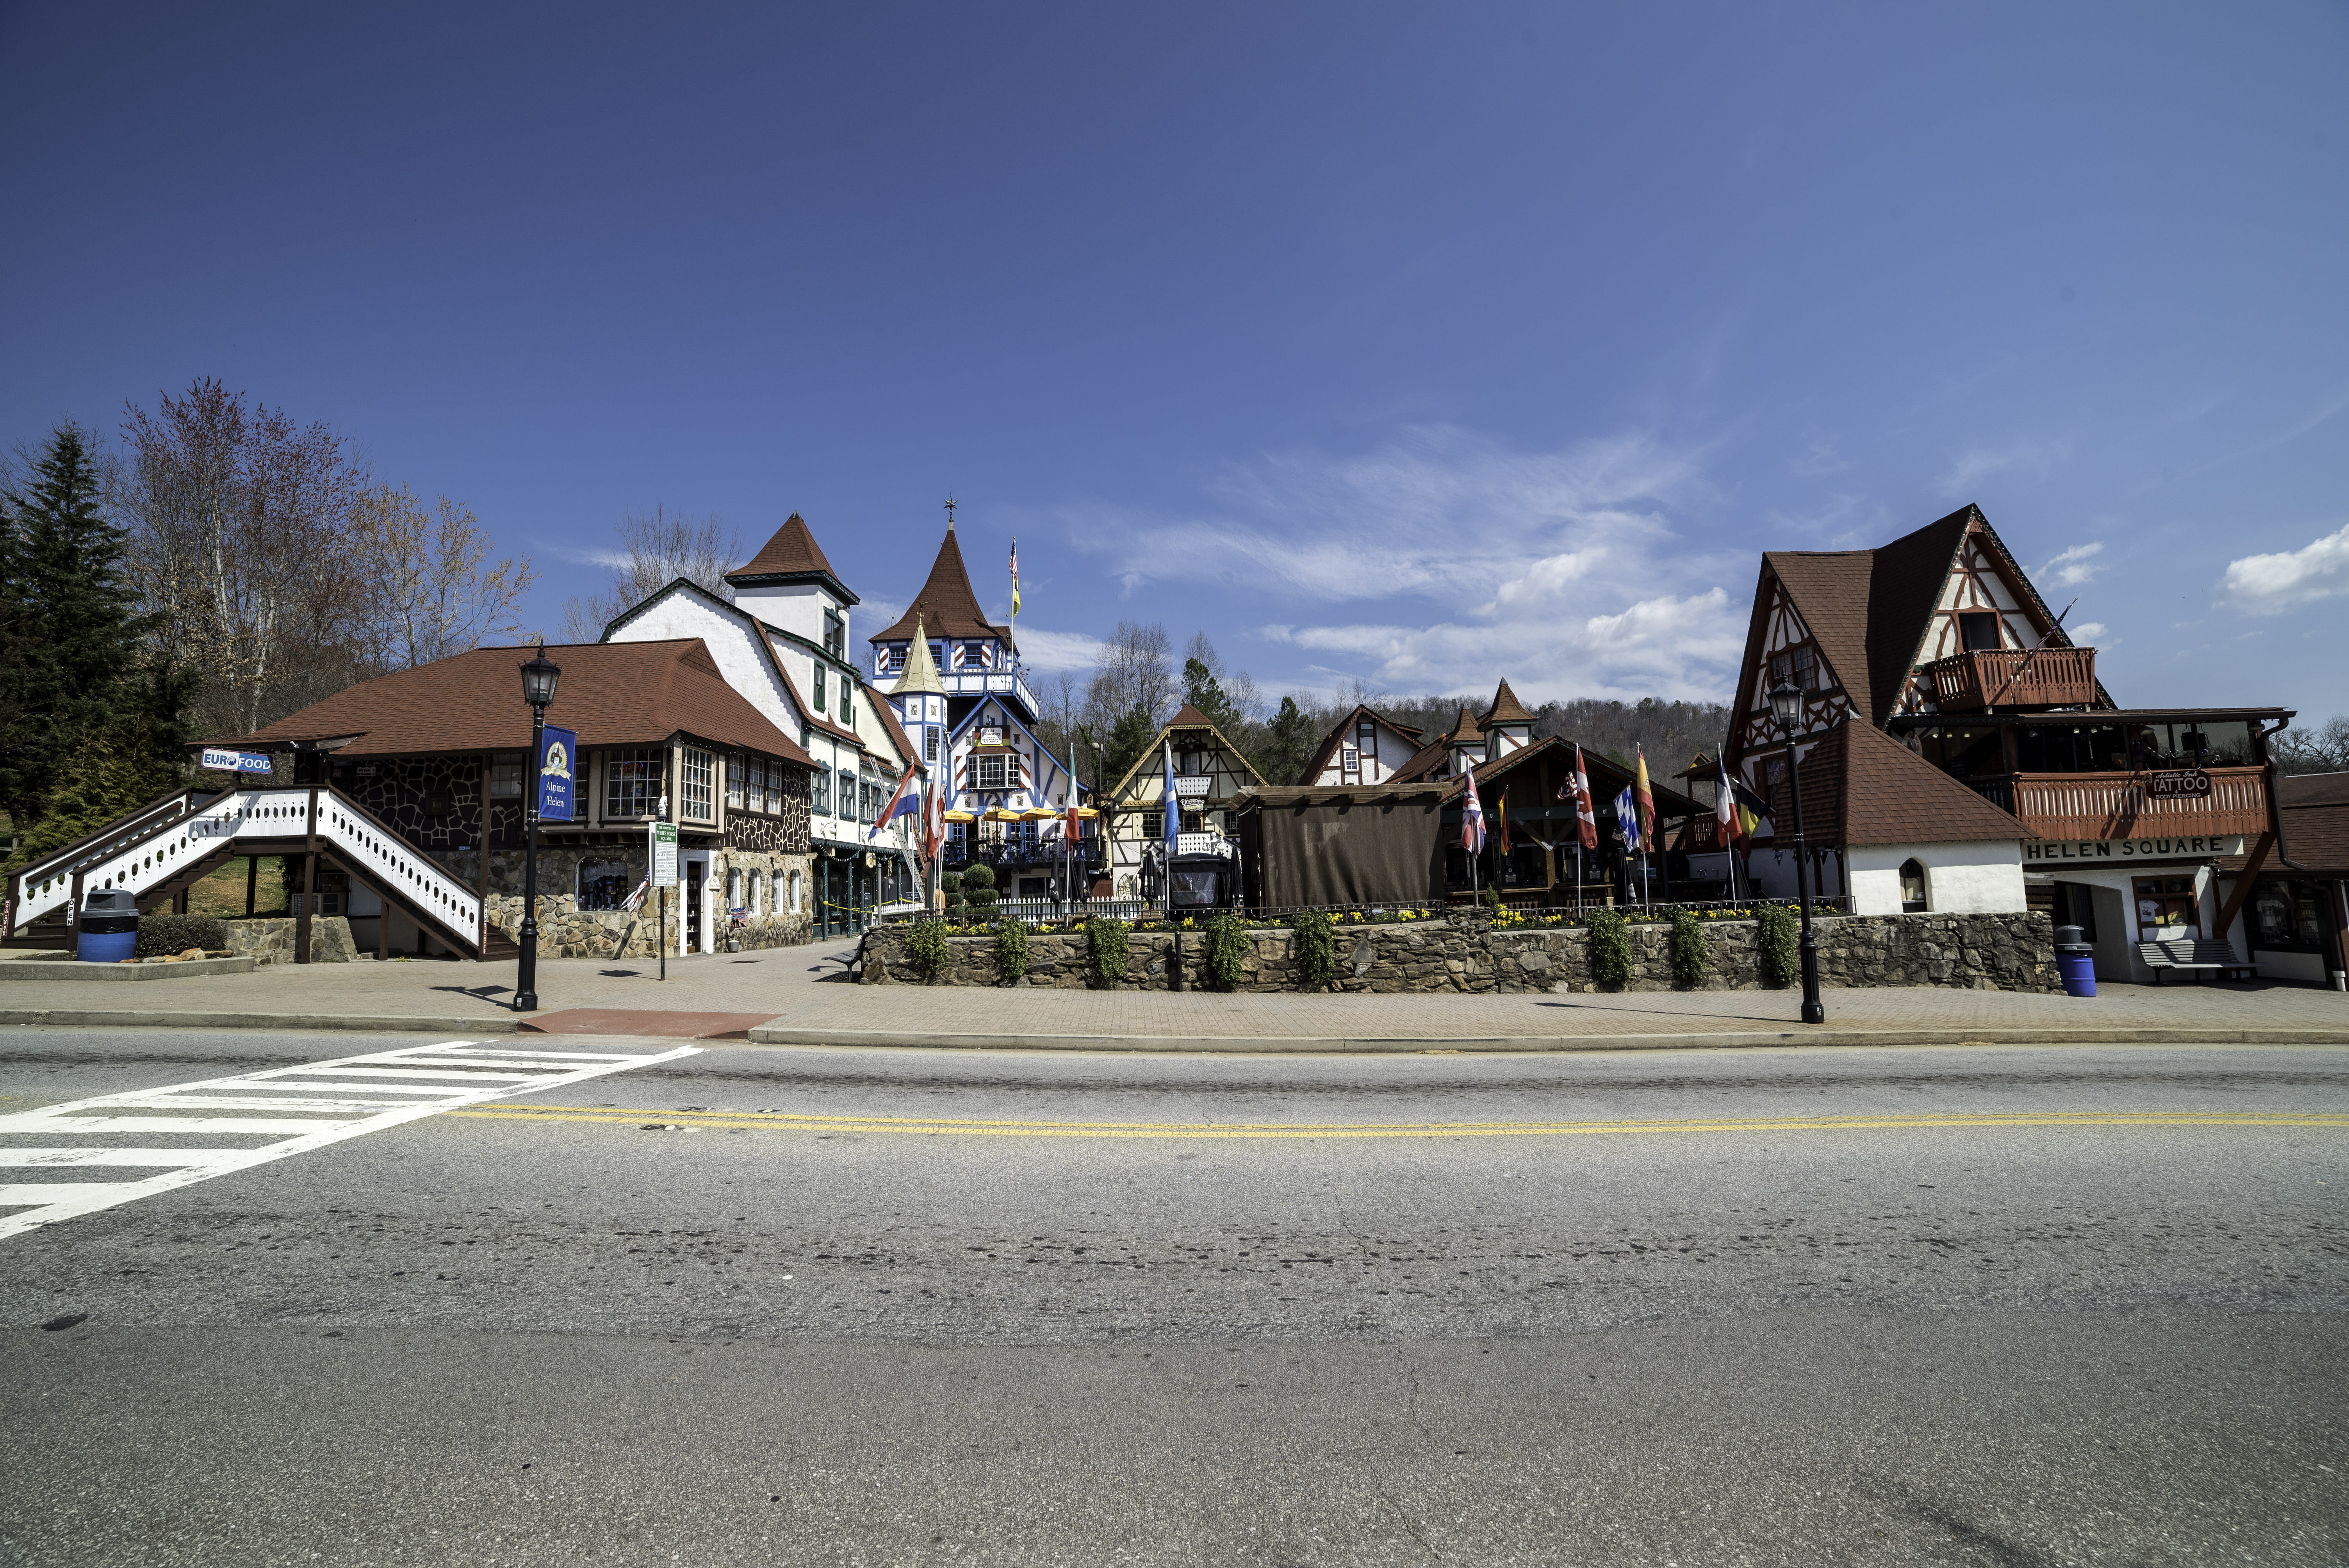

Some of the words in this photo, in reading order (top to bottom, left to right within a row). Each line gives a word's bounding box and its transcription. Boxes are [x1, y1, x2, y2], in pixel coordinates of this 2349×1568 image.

[238, 757, 271, 770] FOOD
[546, 781, 565, 794] Alpine
[2154, 777, 2208, 792] TATTOO
[547, 796, 564, 807] Helen
[2027, 842, 2110, 859] HELEN
[2123, 837, 2223, 855] SQUARE
